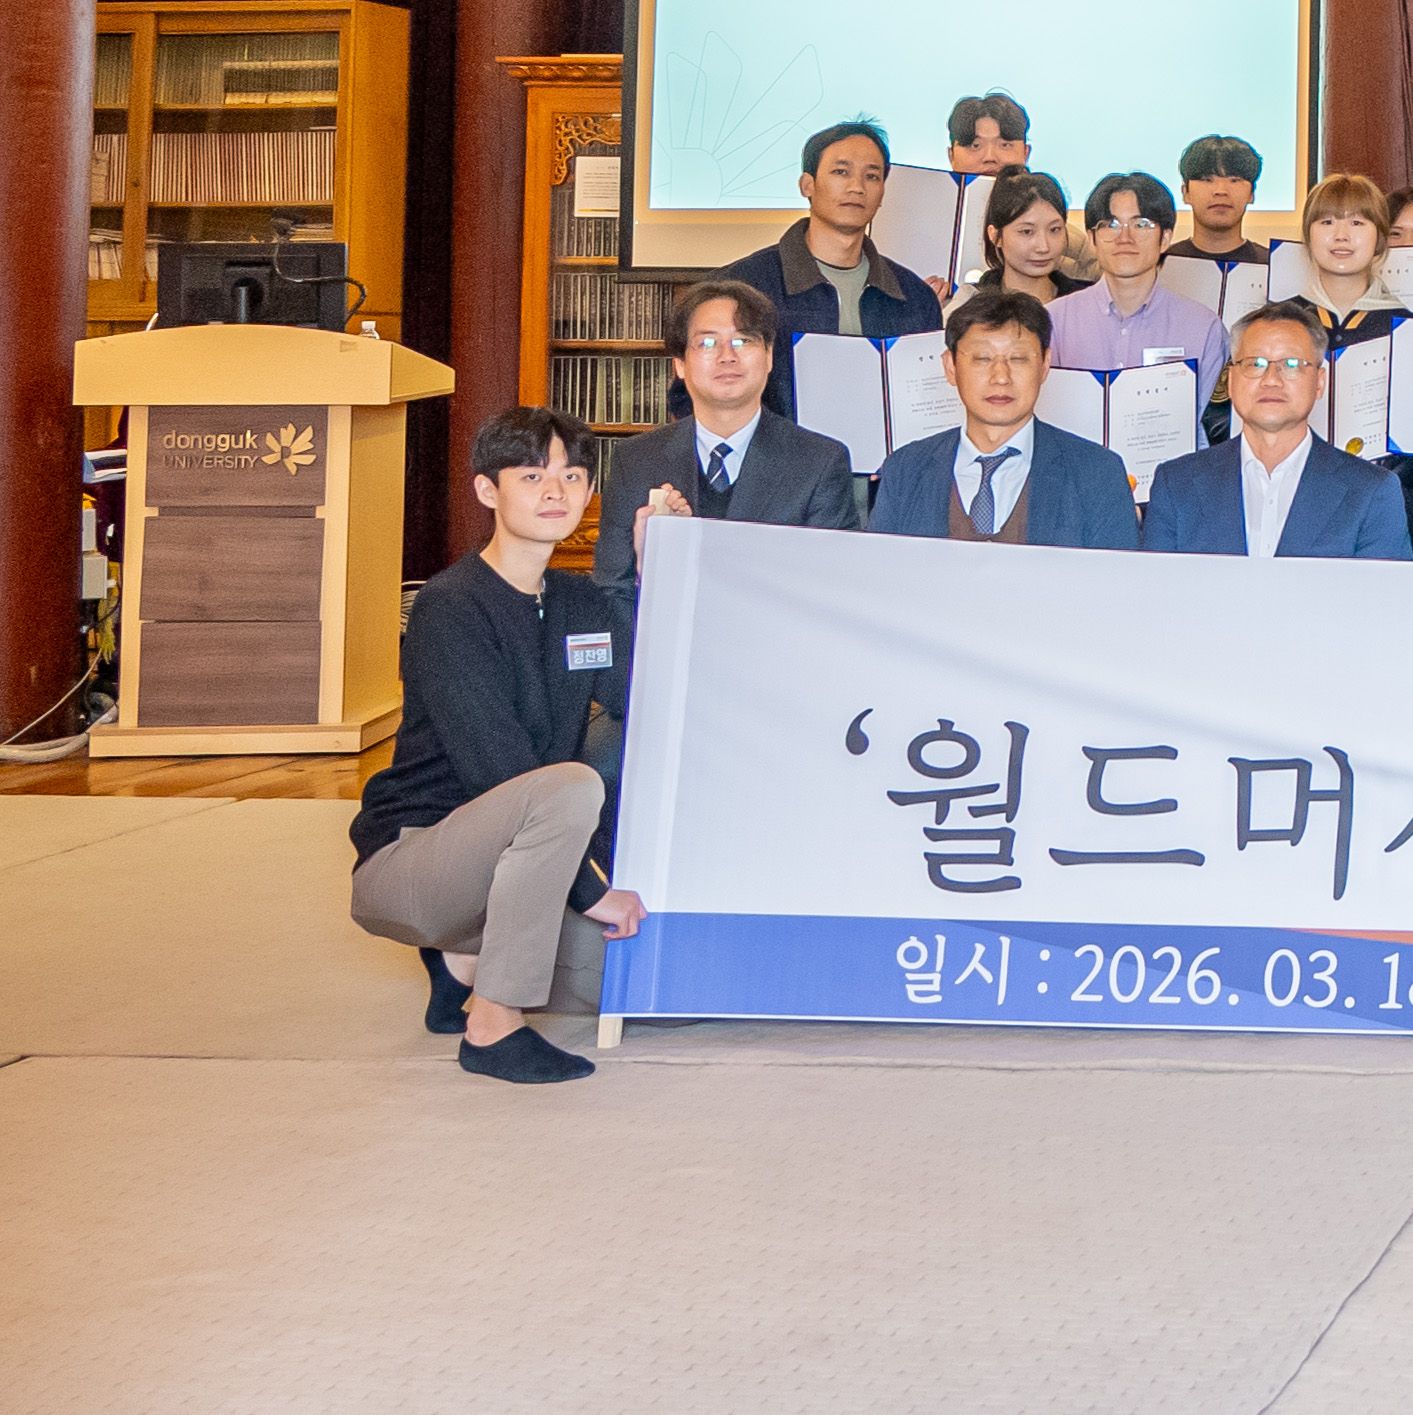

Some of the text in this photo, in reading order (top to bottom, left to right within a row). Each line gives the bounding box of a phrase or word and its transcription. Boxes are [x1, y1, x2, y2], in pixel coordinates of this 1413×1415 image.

[162, 429, 260, 452] dongguk
[162, 454, 260, 470] UNIVERSITY
[896, 934, 1012, 1007] 일시
[1069, 944, 1240, 1007] 2026.
[1263, 949, 1356, 1009] 03.
